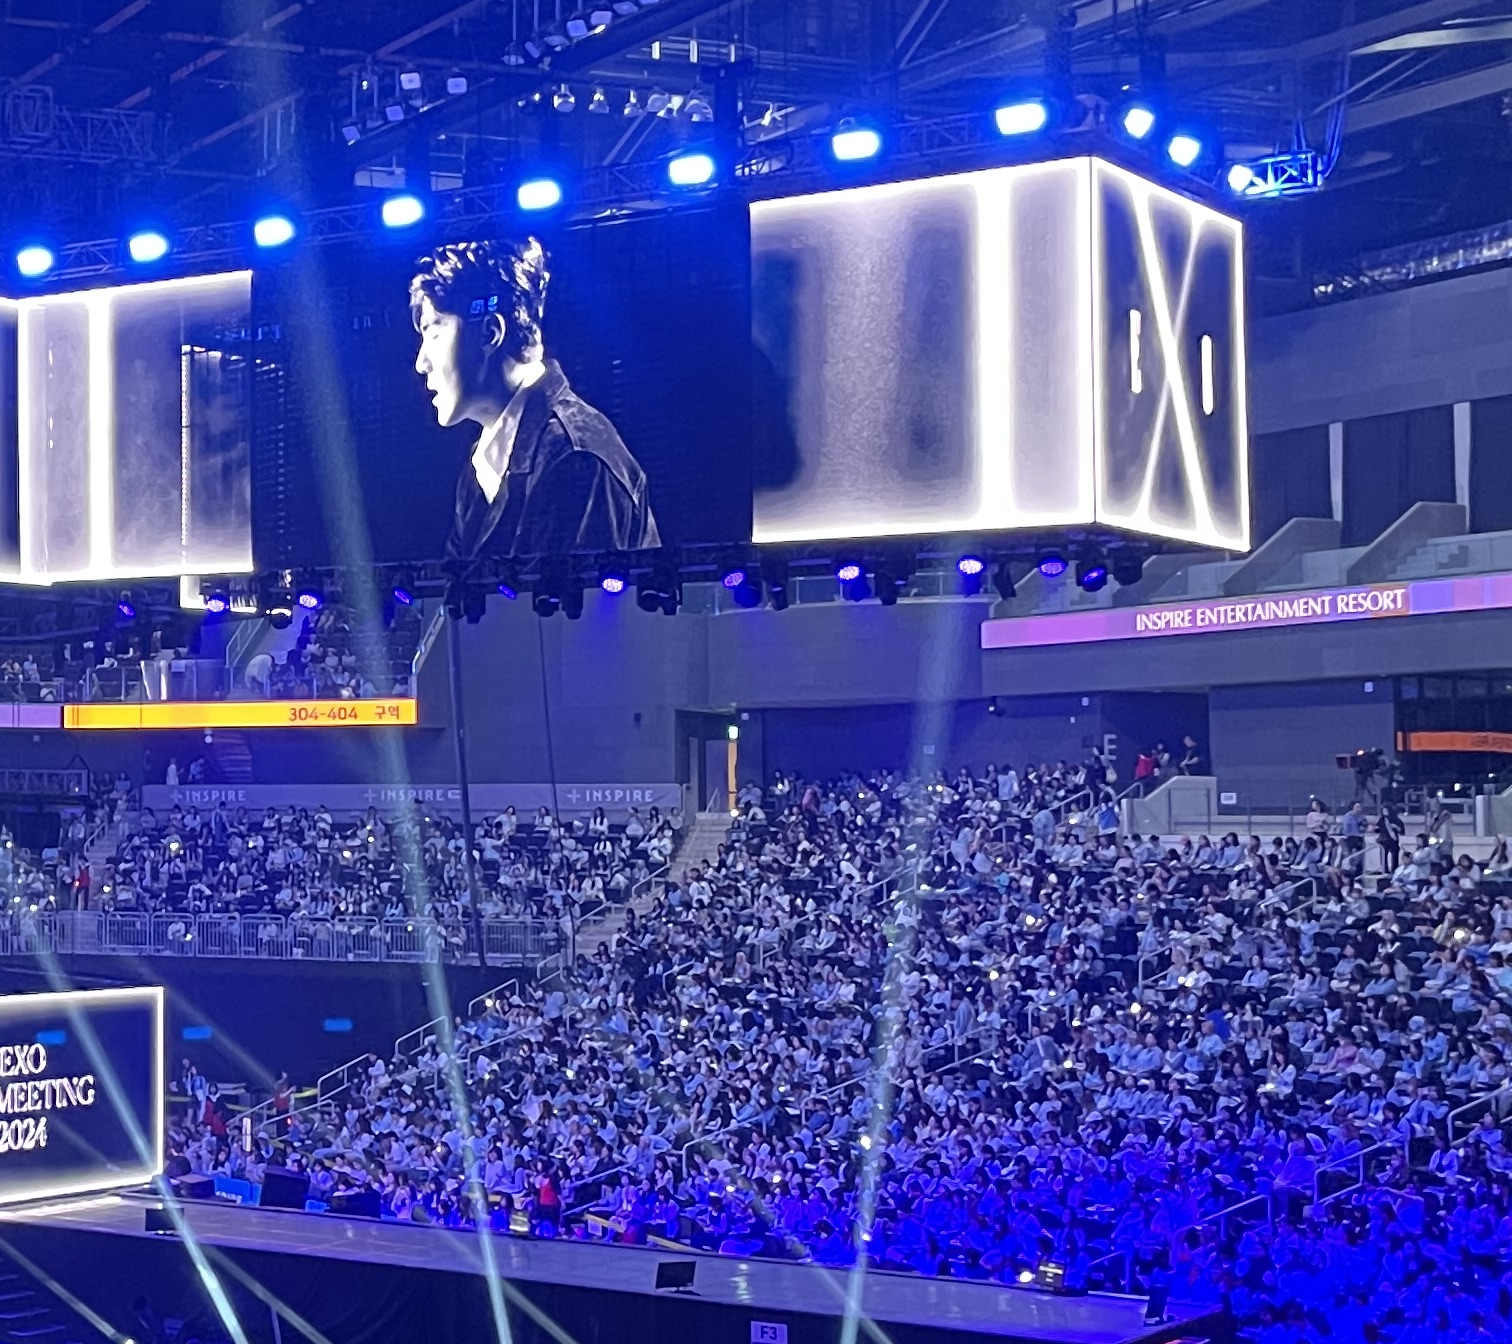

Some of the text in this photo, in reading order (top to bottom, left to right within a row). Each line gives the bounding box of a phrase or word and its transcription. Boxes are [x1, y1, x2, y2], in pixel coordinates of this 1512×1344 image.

[1136, 588, 1406, 632] INSPIRE ENTERTAINMENT RESORT
[288, 705, 400, 722] 304-404 구역
[185, 789, 247, 803] INSPIRE
[380, 788, 445, 802] INSPIRE
[585, 789, 654, 802] INSPIRE
[0, 1042, 47, 1077] EXO
[760, 1325, 778, 1341] F3
